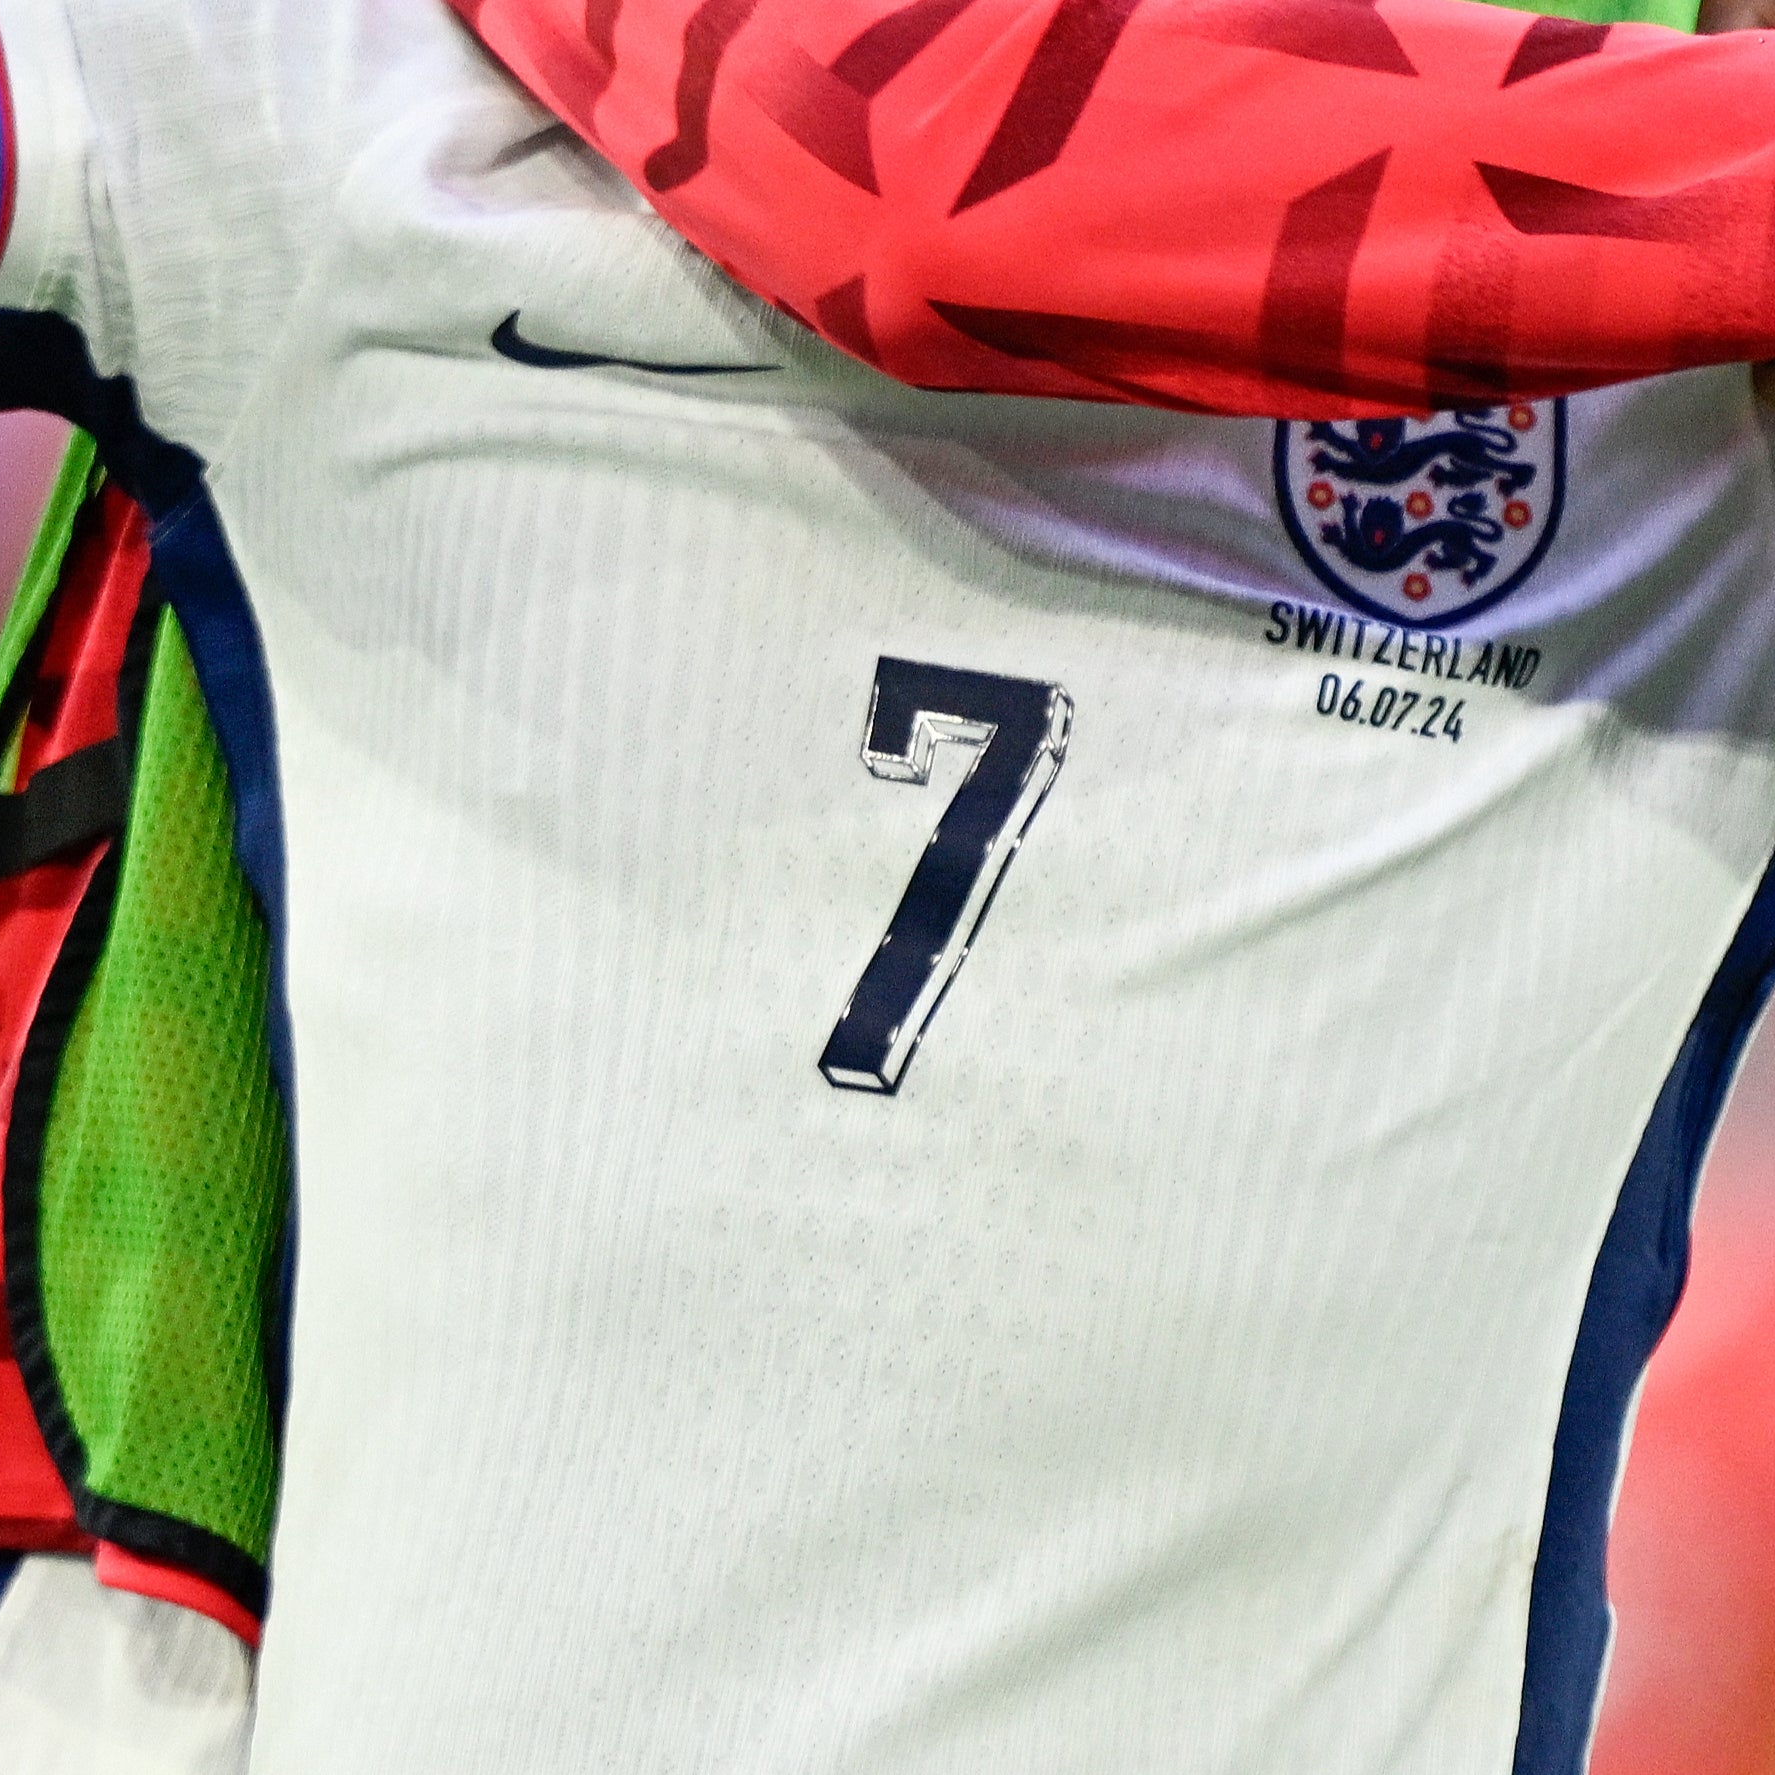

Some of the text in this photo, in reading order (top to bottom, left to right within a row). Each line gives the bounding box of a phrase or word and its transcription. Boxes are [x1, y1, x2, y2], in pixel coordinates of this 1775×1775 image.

[1265, 600, 1542, 690] SWITZERLAND
[1315, 673, 1467, 744] 06.07.24
[817, 654, 1076, 1096] 7
